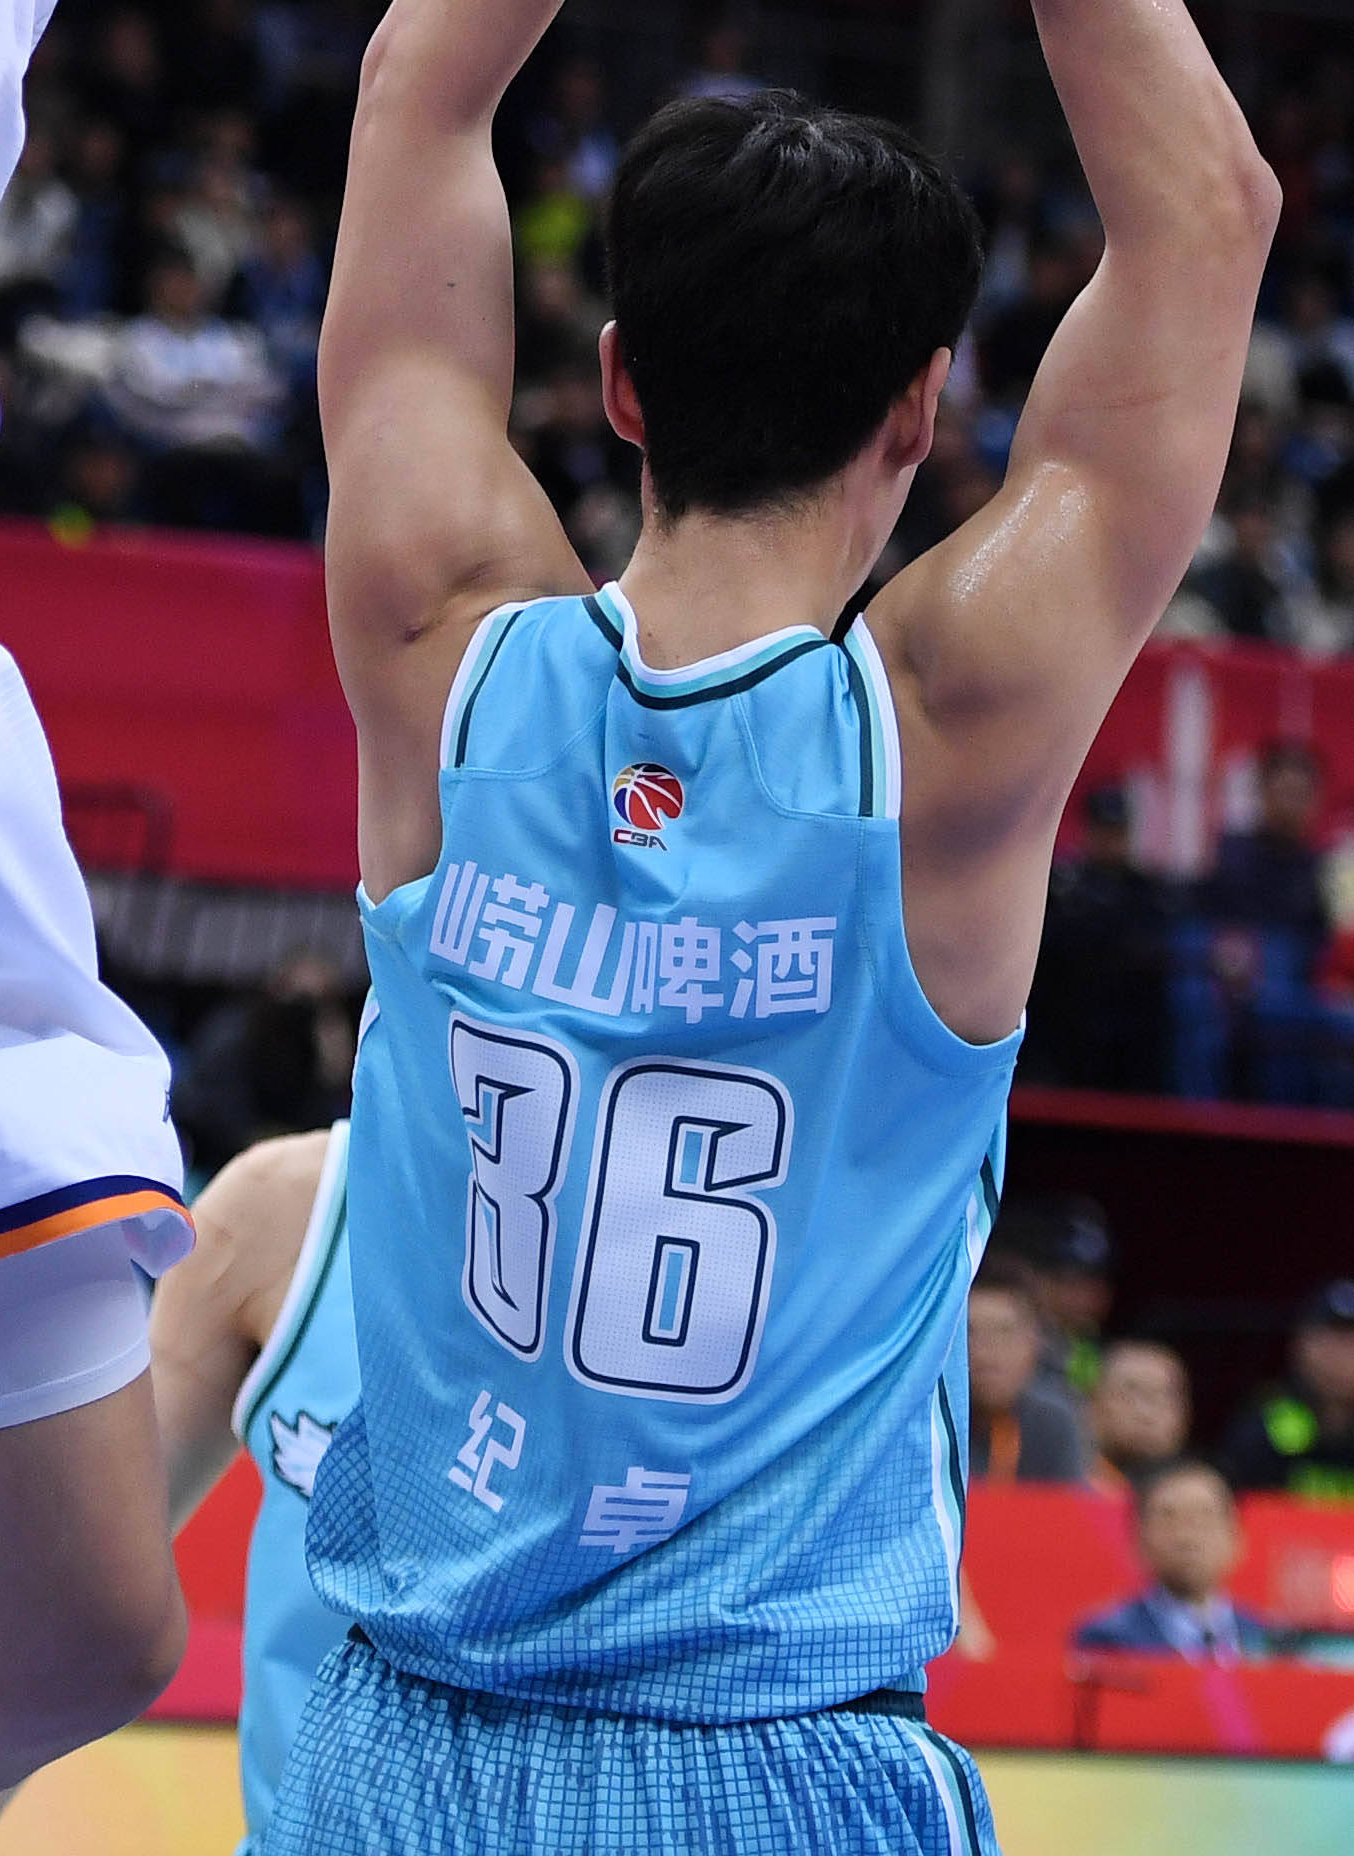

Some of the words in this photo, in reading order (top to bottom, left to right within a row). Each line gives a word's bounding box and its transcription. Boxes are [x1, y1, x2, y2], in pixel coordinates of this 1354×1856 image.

[613, 828, 668, 852] CBA
[429, 861, 838, 1024] 崂山啤酒
[449, 1012, 795, 1404] 36
